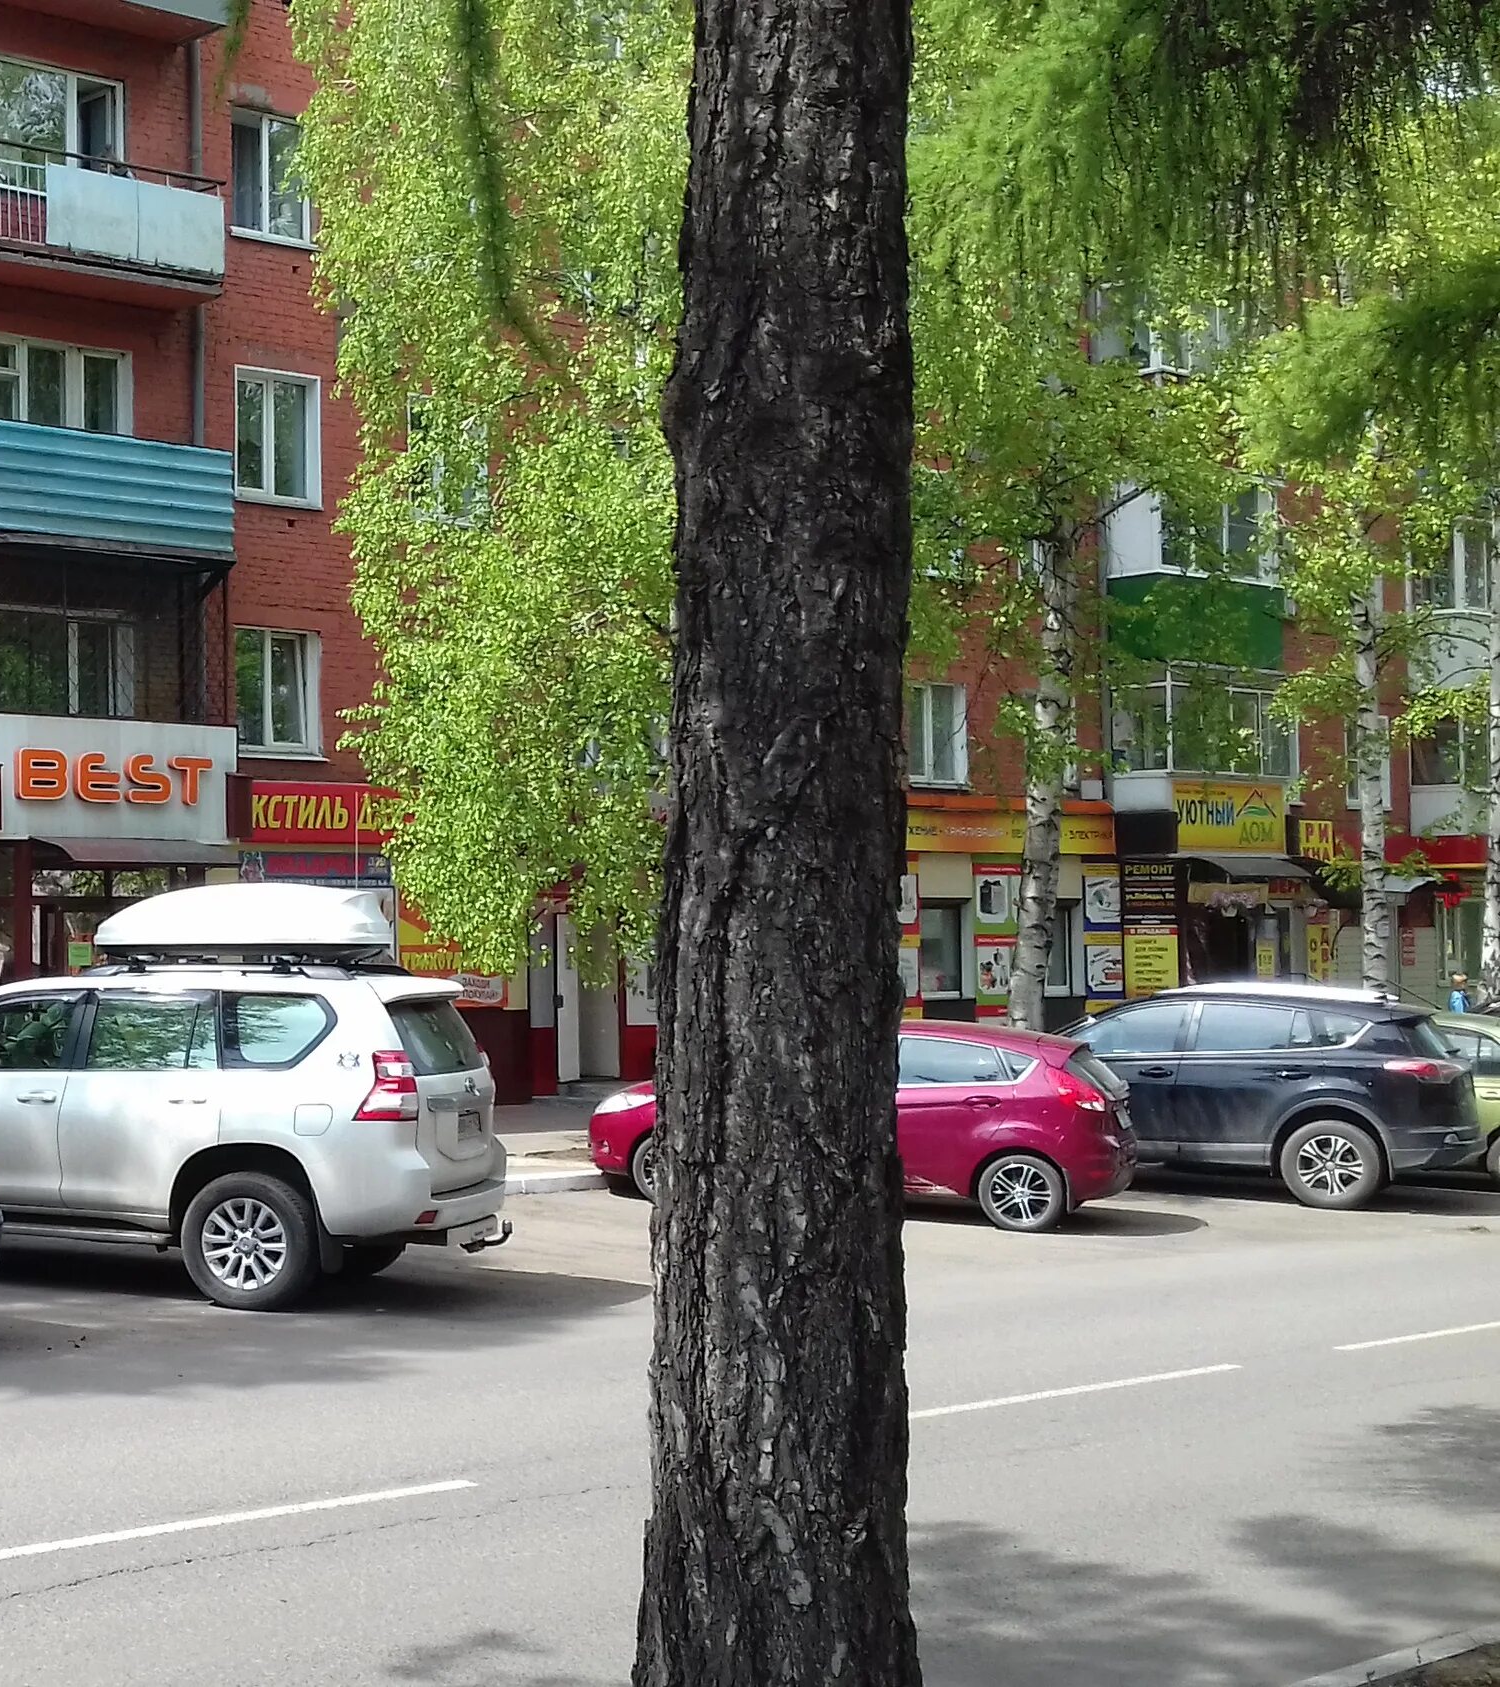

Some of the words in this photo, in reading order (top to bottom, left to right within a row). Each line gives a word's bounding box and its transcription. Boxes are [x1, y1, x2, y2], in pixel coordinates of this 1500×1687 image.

[13, 747, 213, 805] BEST
[252, 794, 349, 829] КСТИЛЬ
[1176, 797, 1234, 826] УЮТНЫЙ
[1239, 822, 1274, 845] ДОМ
[1125, 864, 1175, 875] РЕМОНТ
